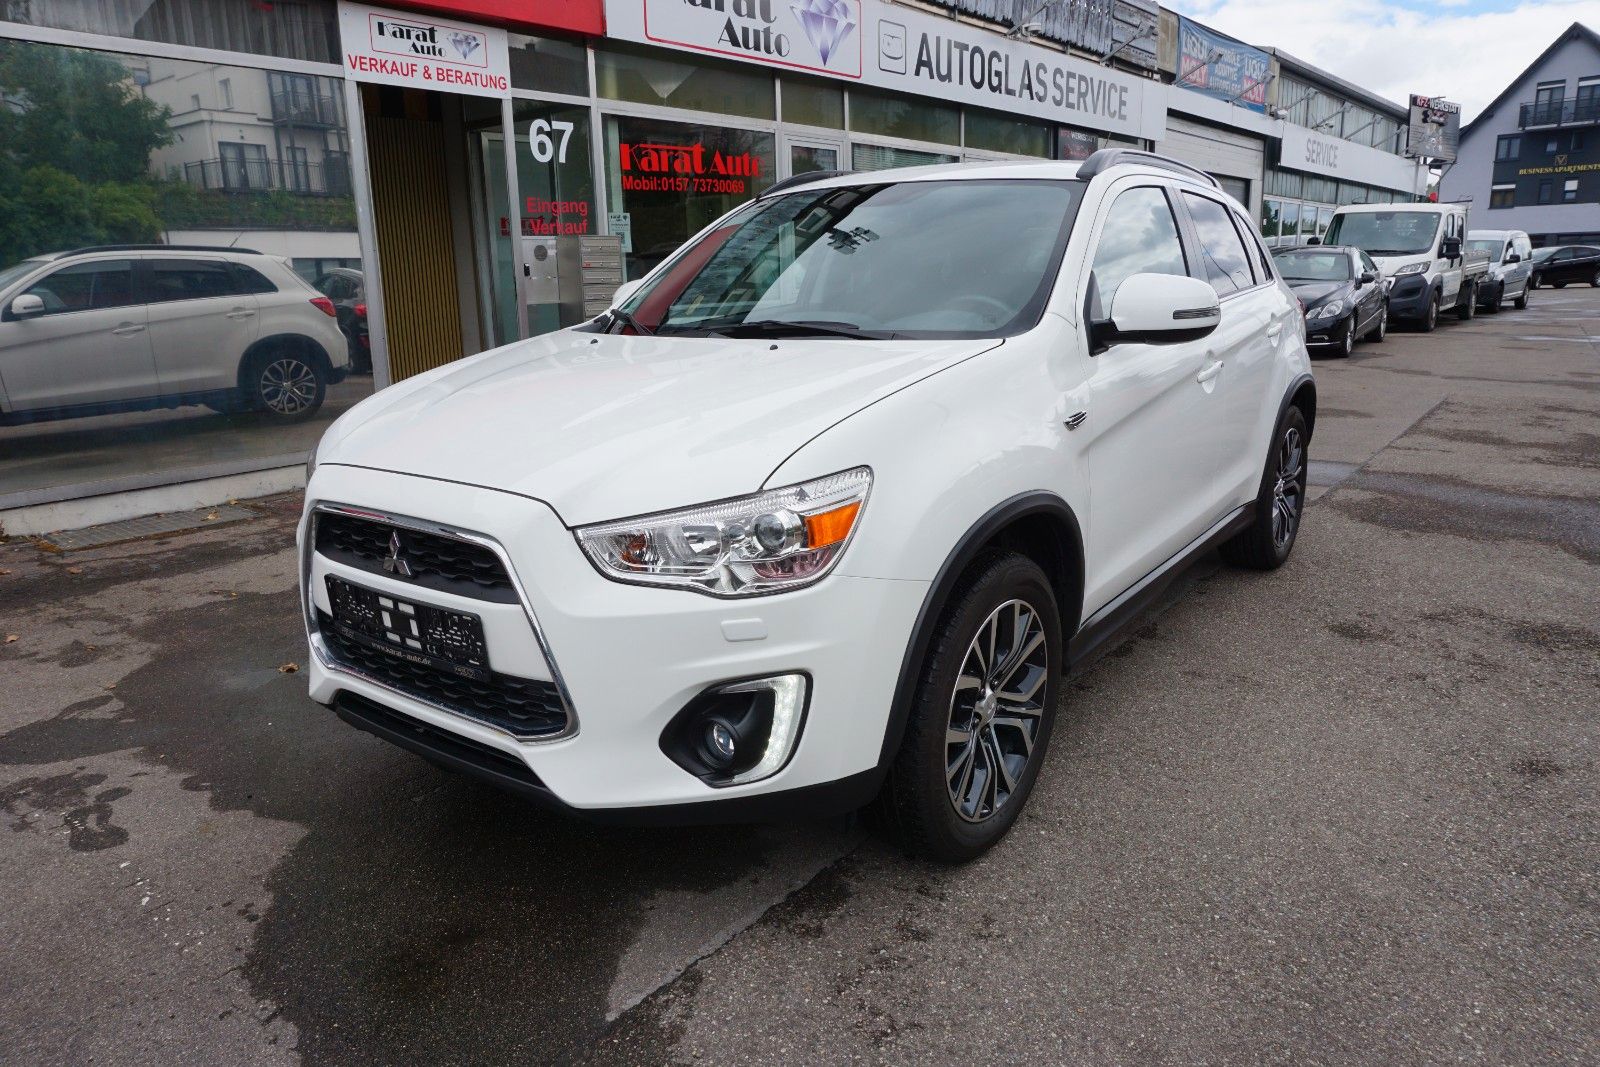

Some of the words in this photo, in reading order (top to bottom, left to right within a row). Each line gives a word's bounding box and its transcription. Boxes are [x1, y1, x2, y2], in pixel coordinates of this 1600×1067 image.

[377, 21, 439, 44] Karat
[717, 16, 791, 58] Auto
[408, 42, 448, 58] Auto
[347, 54, 418, 79] VERKAUF
[423, 66, 432, 80] &
[436, 67, 508, 91] BERATUNG
[529, 118, 574, 164] 67
[620, 143, 706, 175] Karat
[709, 149, 766, 181] Auto
[1305, 137, 1339, 169] SERVICE
[1518, 166, 1553, 177] BUSINESS
[693, 178, 745, 194] 73730069
[526, 197, 588, 216] Eingang
[530, 218, 588, 236] Verkauf
